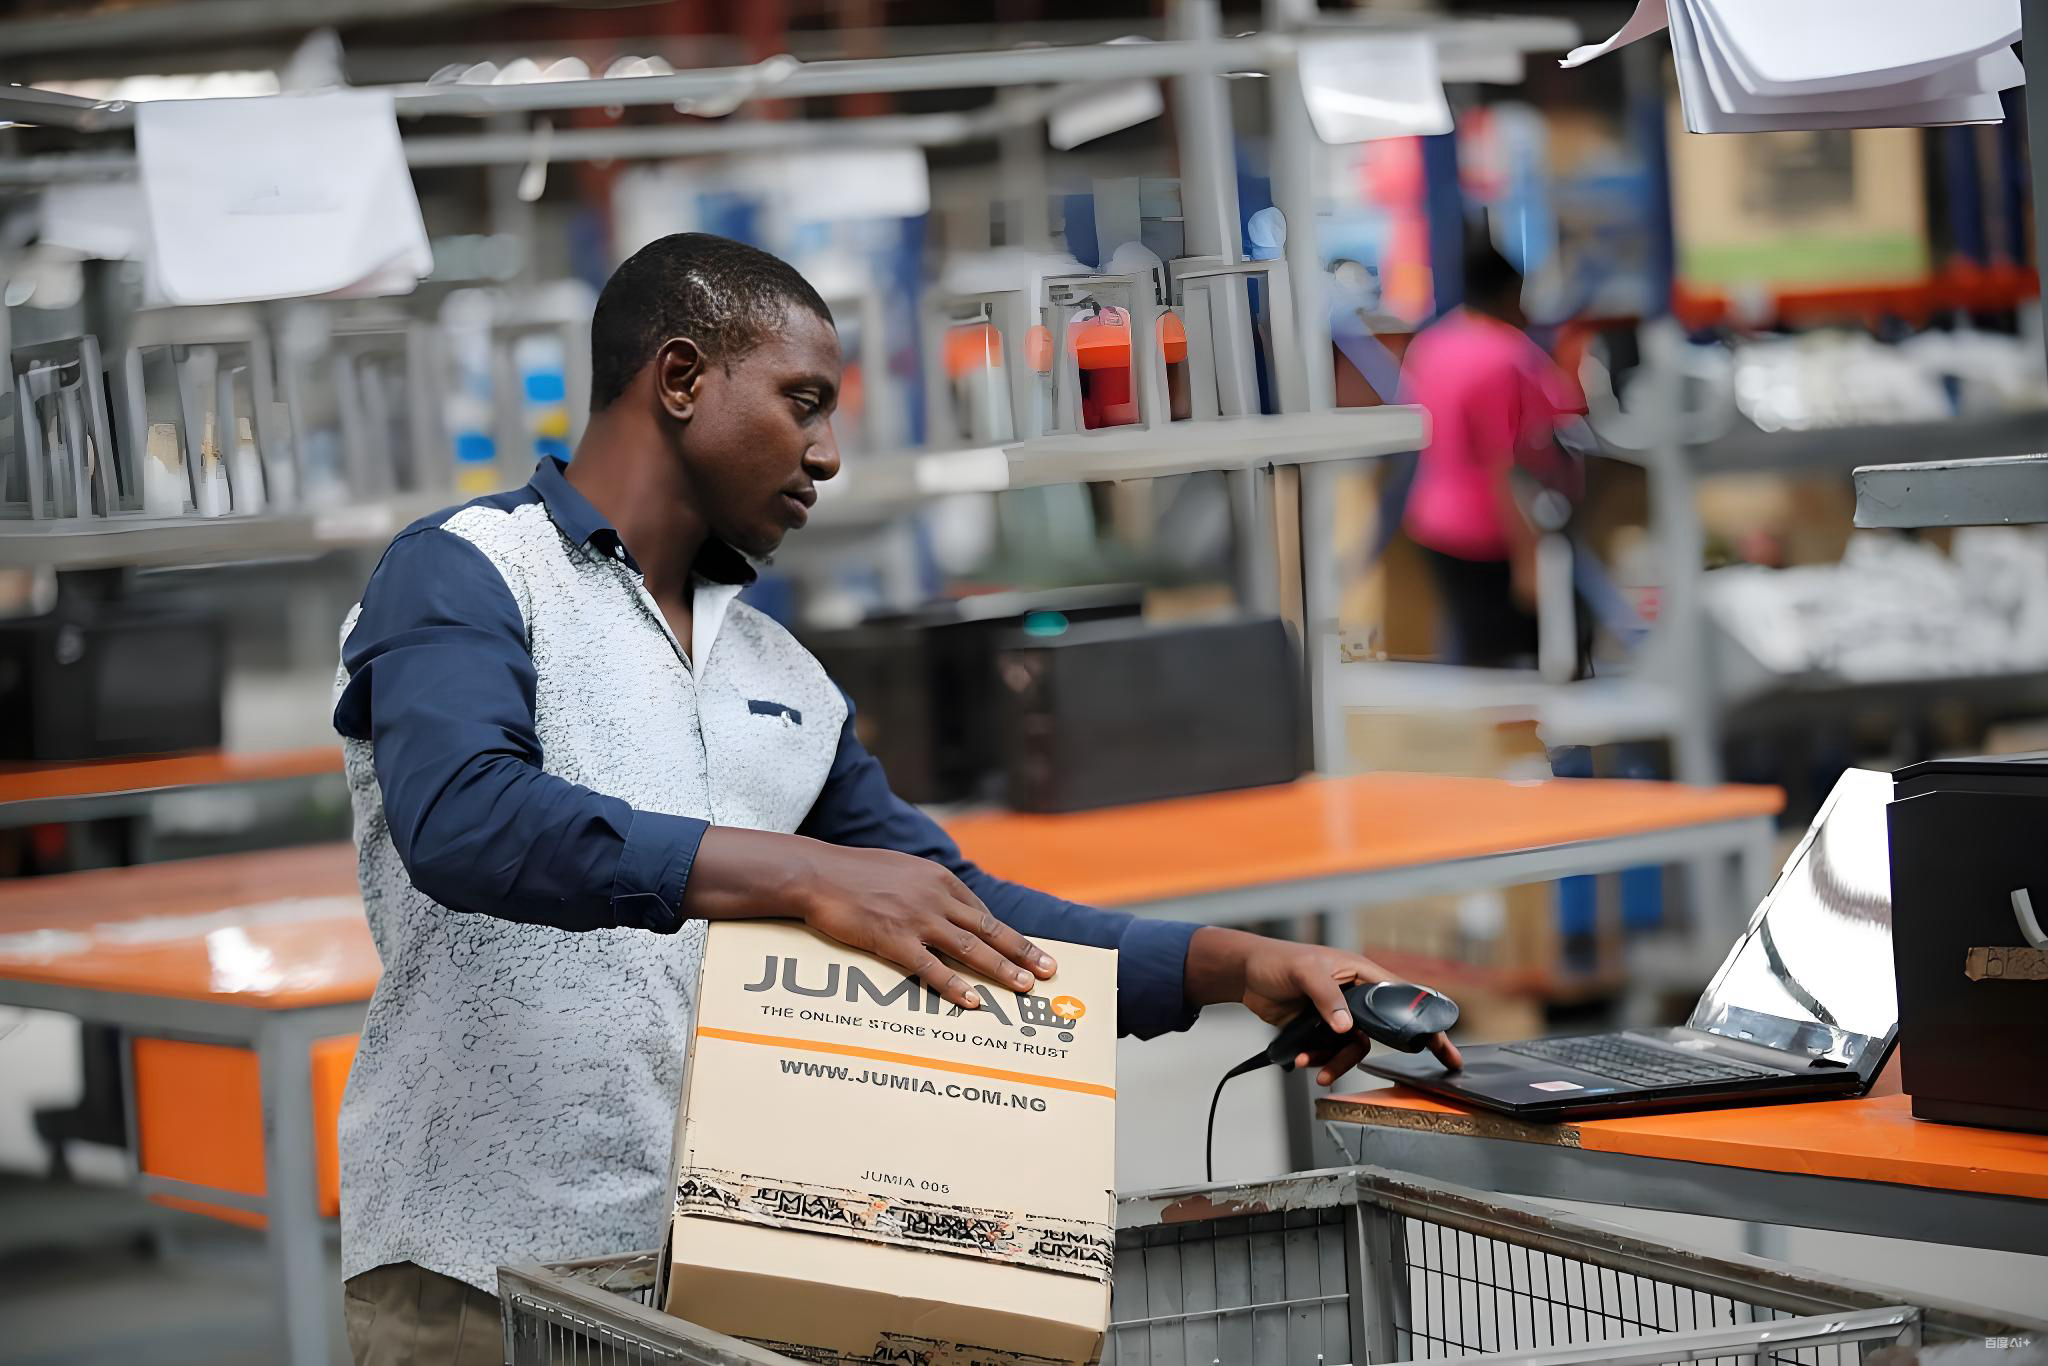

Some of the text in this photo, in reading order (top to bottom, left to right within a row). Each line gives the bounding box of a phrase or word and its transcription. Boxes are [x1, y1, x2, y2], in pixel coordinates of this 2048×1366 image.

[760, 1005, 1069, 1059] THE ONLINE STORE YOU CAN TRUST
[780, 1059, 1047, 1112] WWW.JUMIA.COM.NG
[861, 1170, 950, 1194] JUMIA 005
